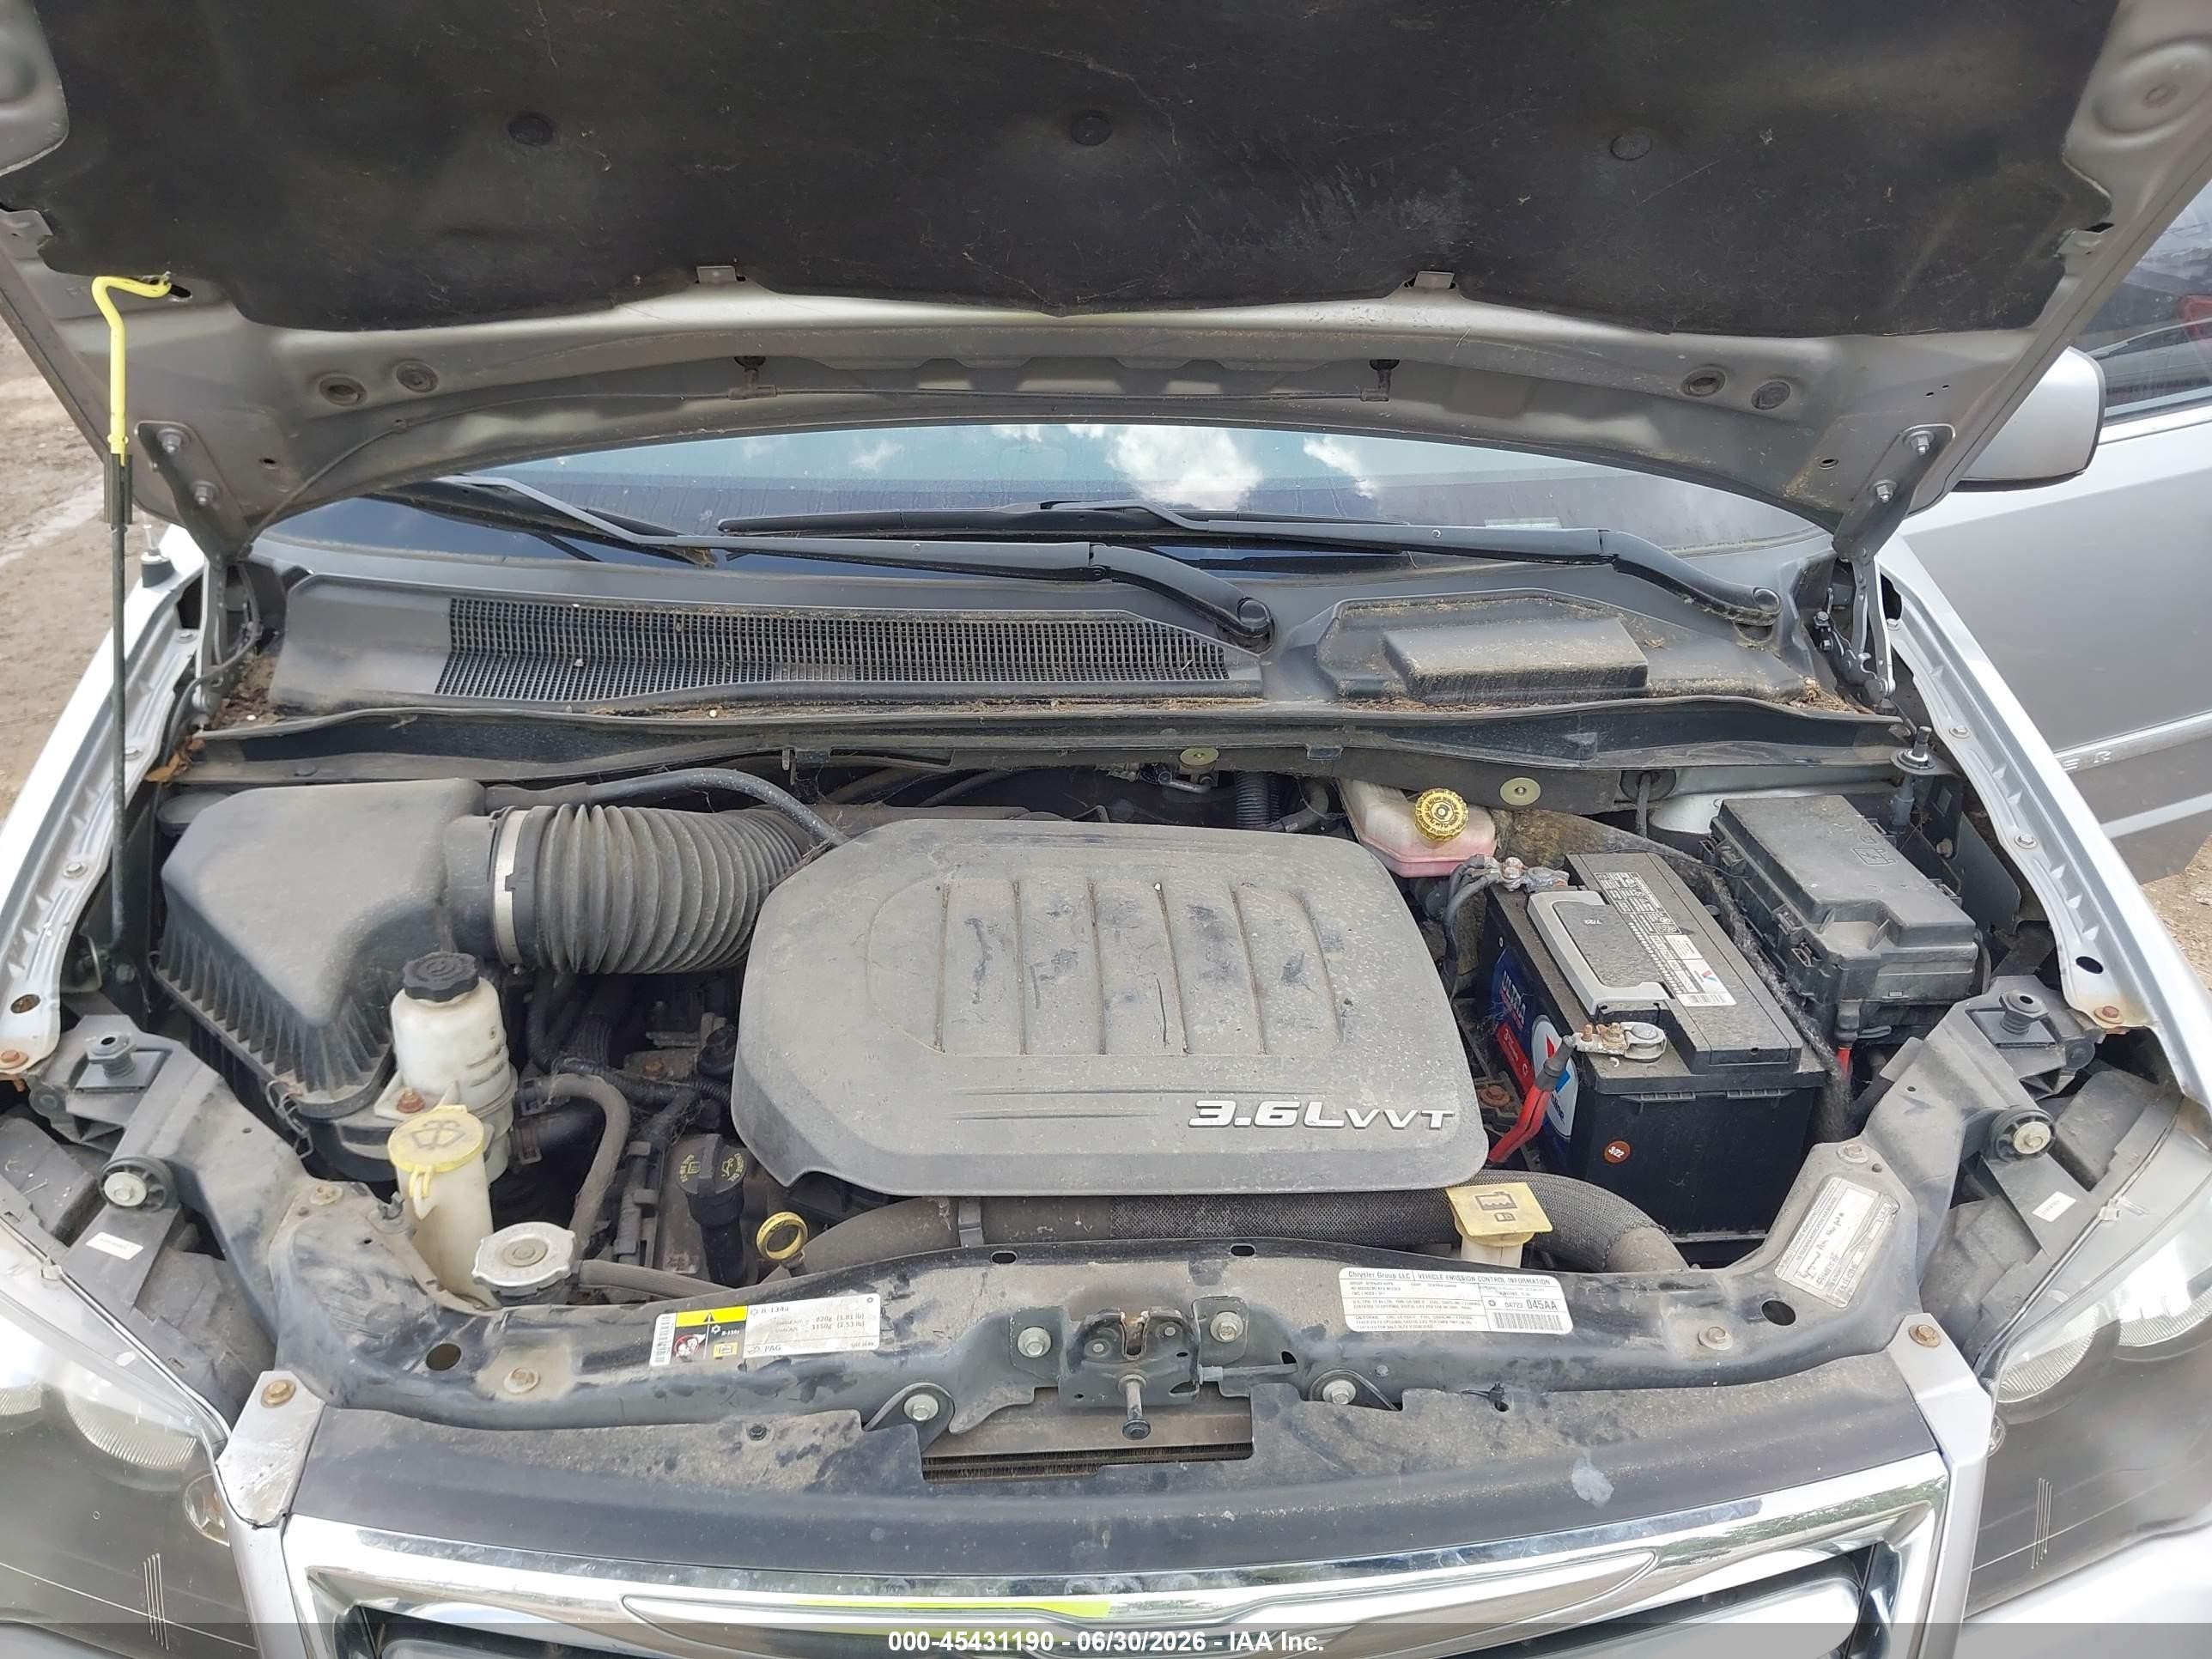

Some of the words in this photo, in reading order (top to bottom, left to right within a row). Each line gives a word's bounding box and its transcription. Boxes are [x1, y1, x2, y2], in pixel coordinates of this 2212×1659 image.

[1502, 969, 1527, 1026] ULTRA
[1188, 1101, 1345, 1127] 3.6L
[1346, 1108, 1455, 1130] VVT
[1608, 1146, 1625, 1158] 3/22
[1348, 1271, 1375, 1279] Chrysler
[1376, 1272, 1397, 1280] Group
[1477, 1275, 1506, 1284] CONTROL
[1507, 1277, 1551, 1285] INFORMATION
[1526, 1299, 1559, 1310] 045AA
[764, 1344, 781, 1352] PAG
